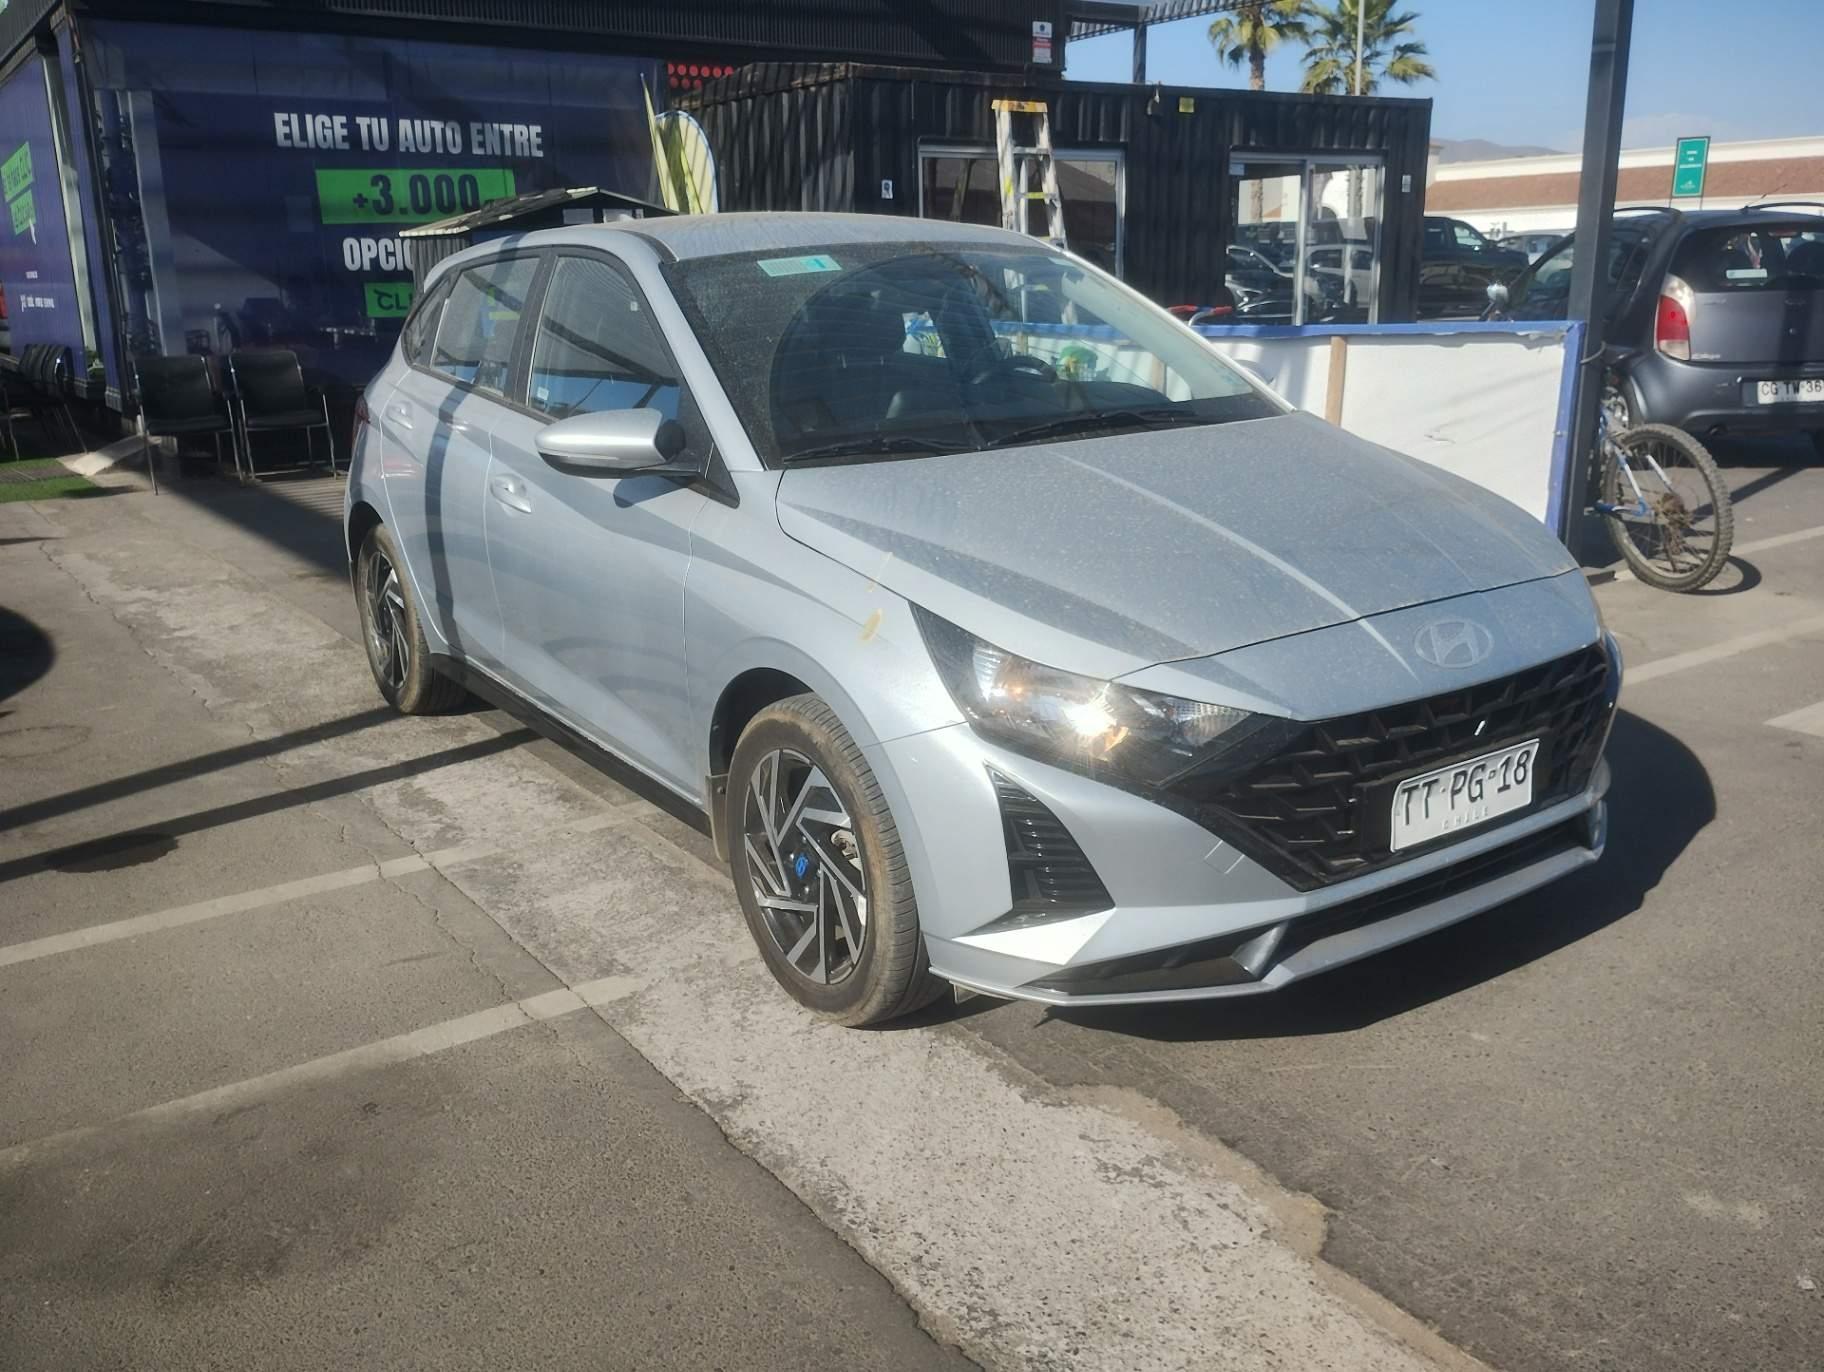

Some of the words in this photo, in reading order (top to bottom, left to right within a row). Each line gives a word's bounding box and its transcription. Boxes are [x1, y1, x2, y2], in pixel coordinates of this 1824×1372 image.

[273, 112, 350, 150] ELIGE
[355, 116, 390, 152] TU
[398, 119, 463, 155] AUTO
[470, 122, 544, 158] ENTRE
[353, 174, 480, 216] +3.000
[1442, 806, 1489, 830] CHILE
